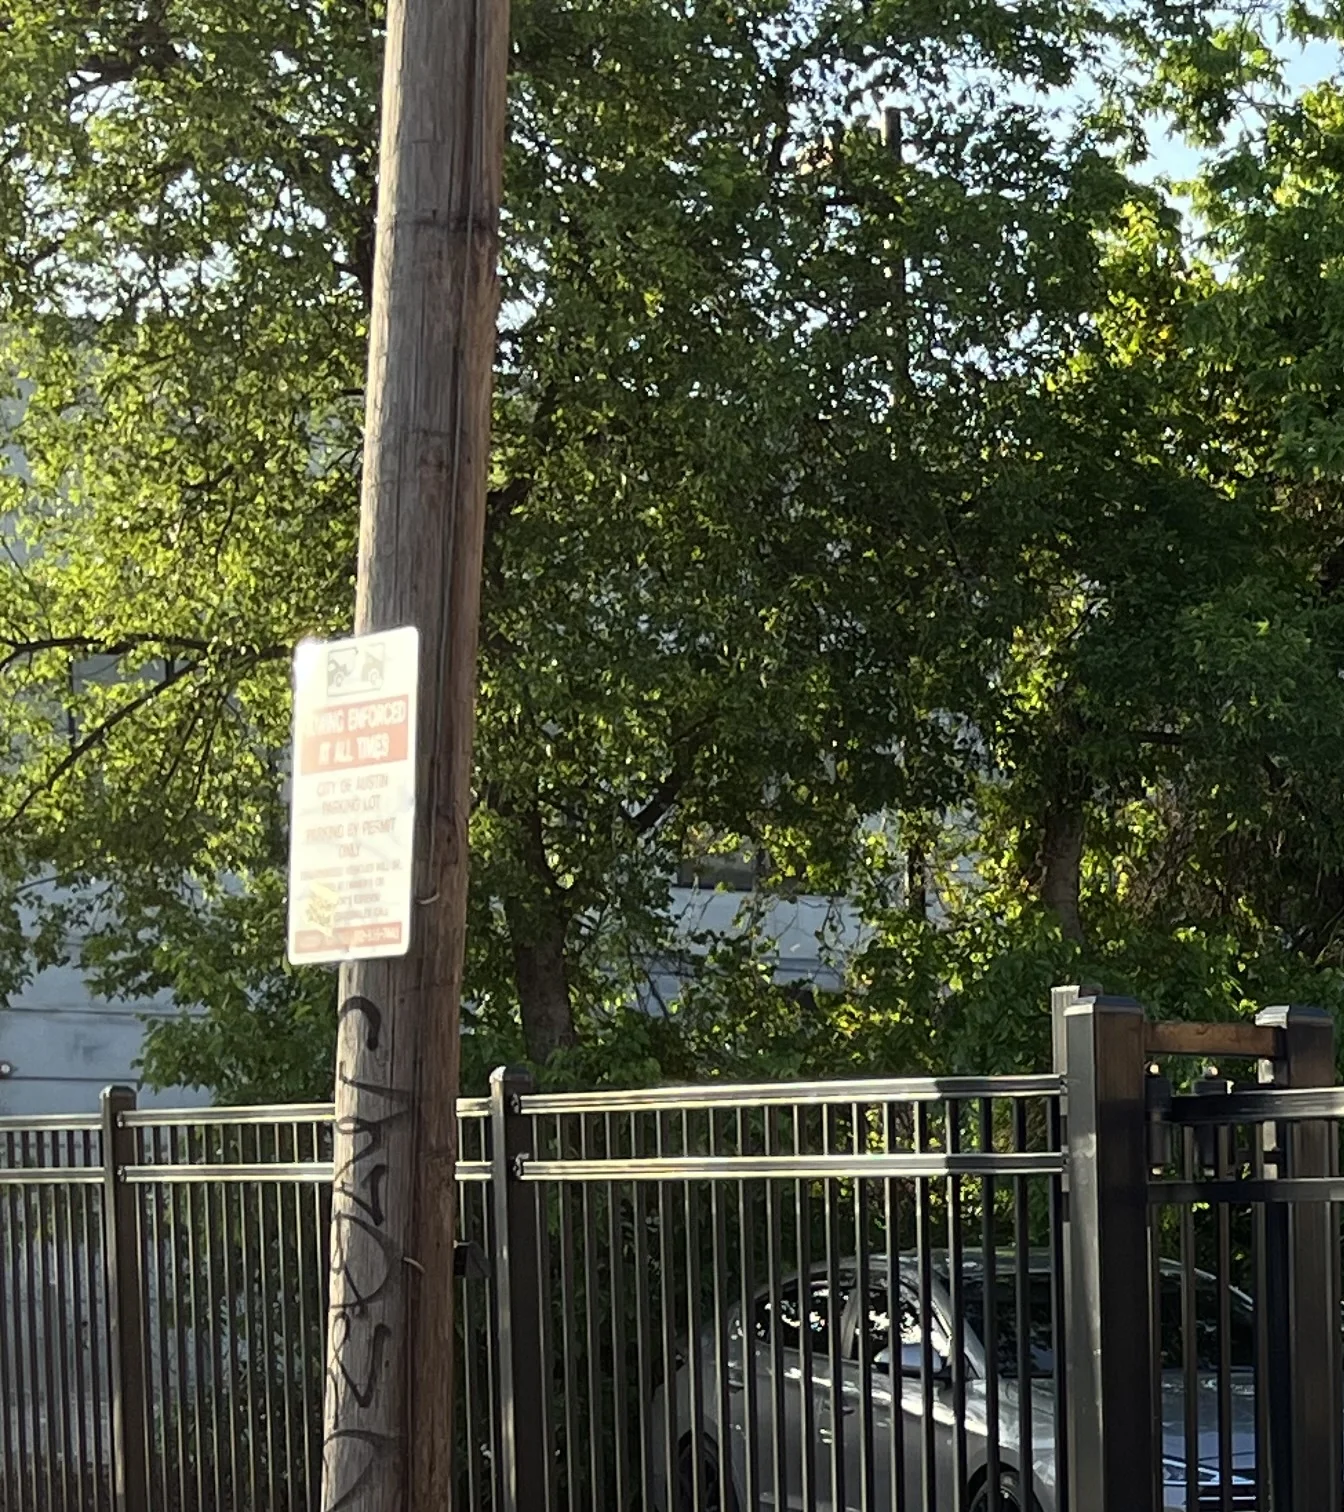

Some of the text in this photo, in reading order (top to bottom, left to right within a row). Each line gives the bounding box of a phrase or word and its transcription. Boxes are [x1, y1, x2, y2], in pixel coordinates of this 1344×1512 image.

[347, 700, 406, 731] ENFORCED
[333, 738, 353, 763] ALL
[356, 732, 390, 760] TIMES
[316, 780, 336, 798] CITY
[356, 773, 388, 791] AUSTIN
[322, 794, 381, 816] PARKING LOT
[306, 823, 344, 843] PARKING
[362, 816, 397, 836] PERMIT
